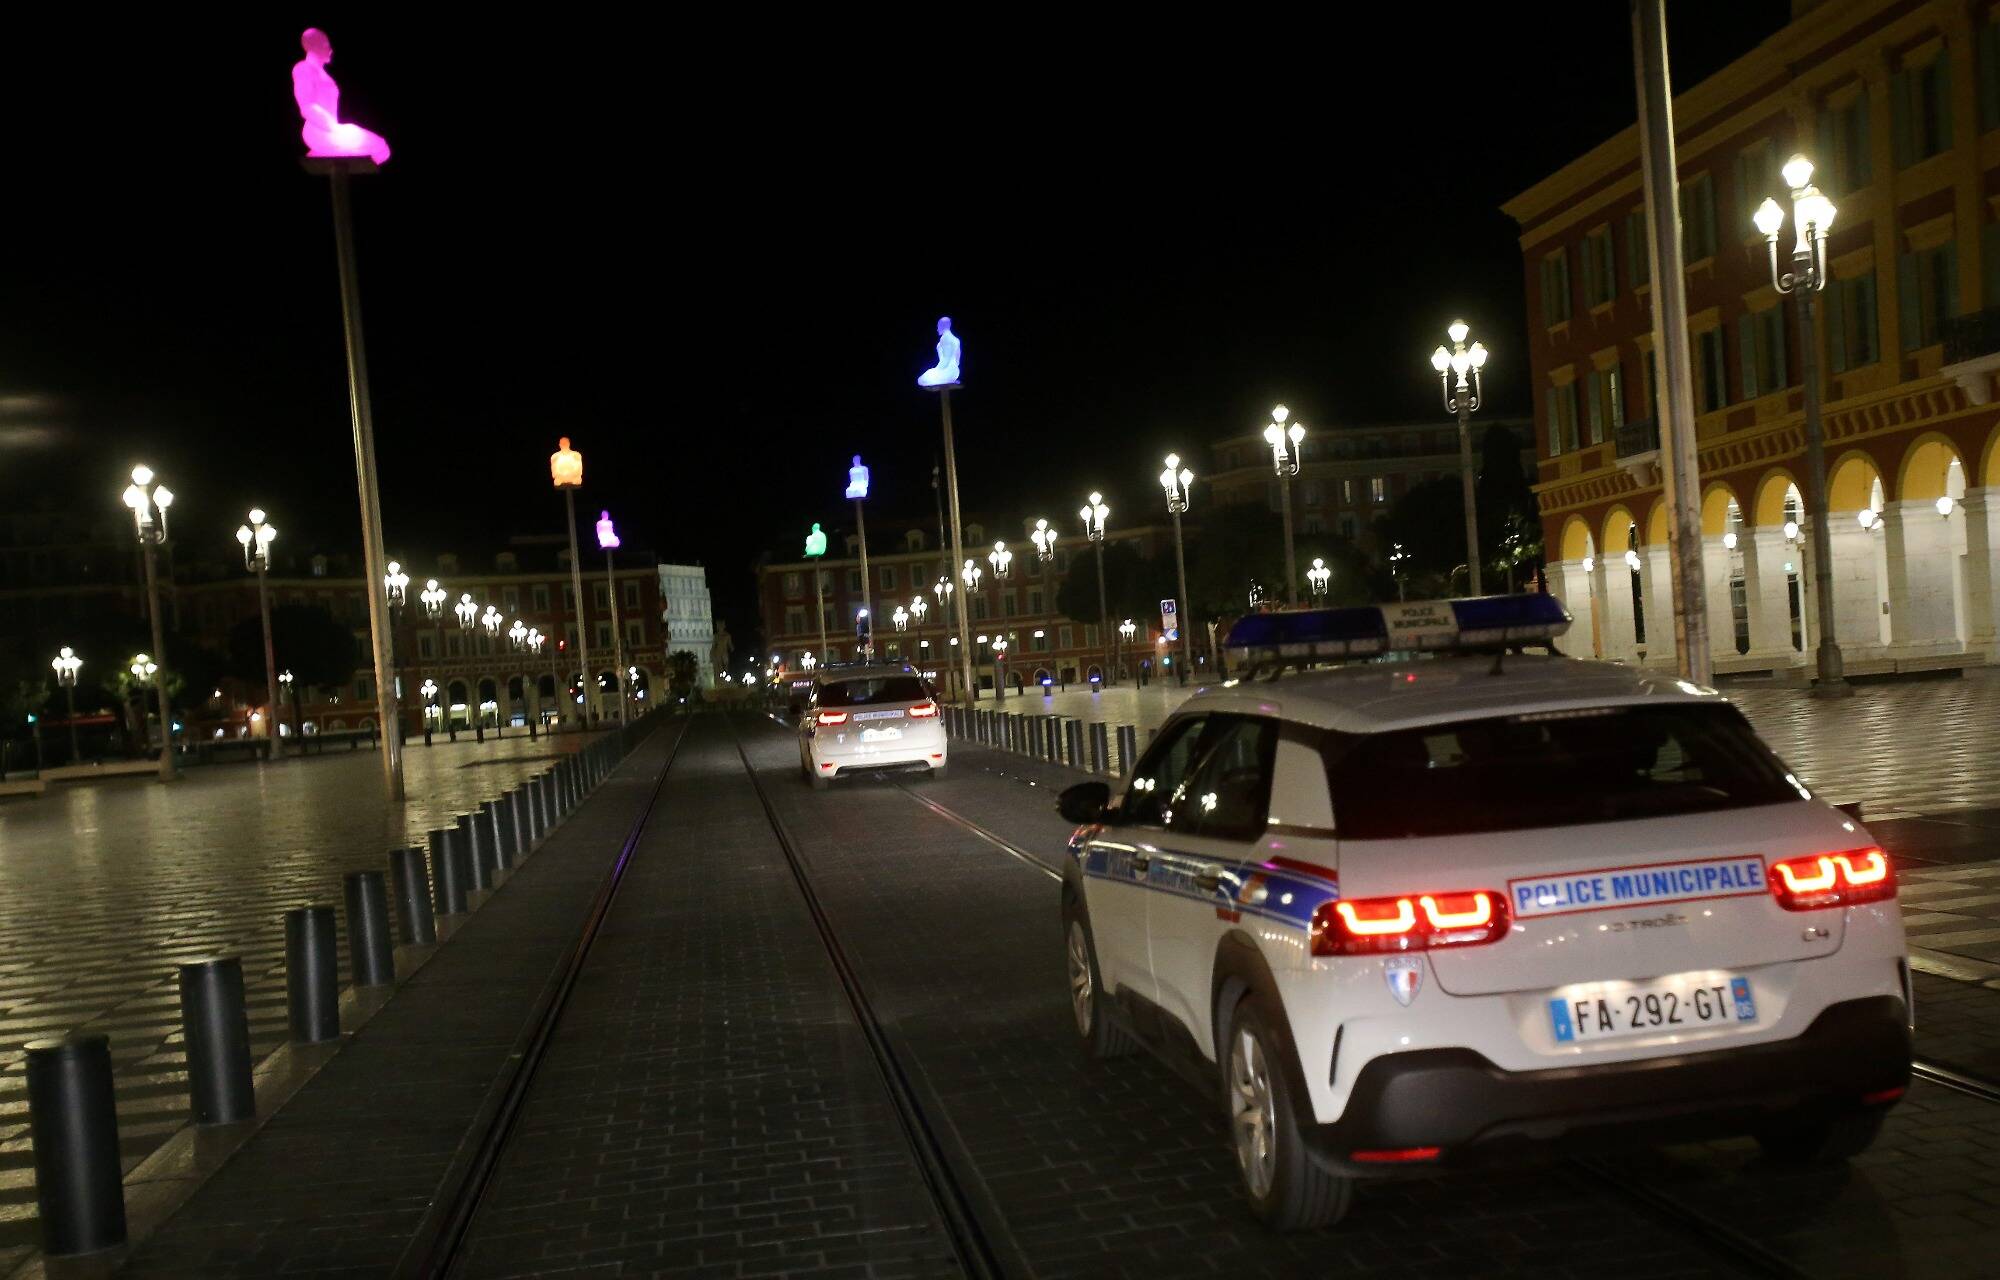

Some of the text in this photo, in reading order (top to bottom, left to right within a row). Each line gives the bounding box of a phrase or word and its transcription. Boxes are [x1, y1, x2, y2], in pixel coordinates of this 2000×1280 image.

[1402, 607, 1432, 616] POLICE
[1517, 863, 1764, 909] POLICE MUNICIPALE
